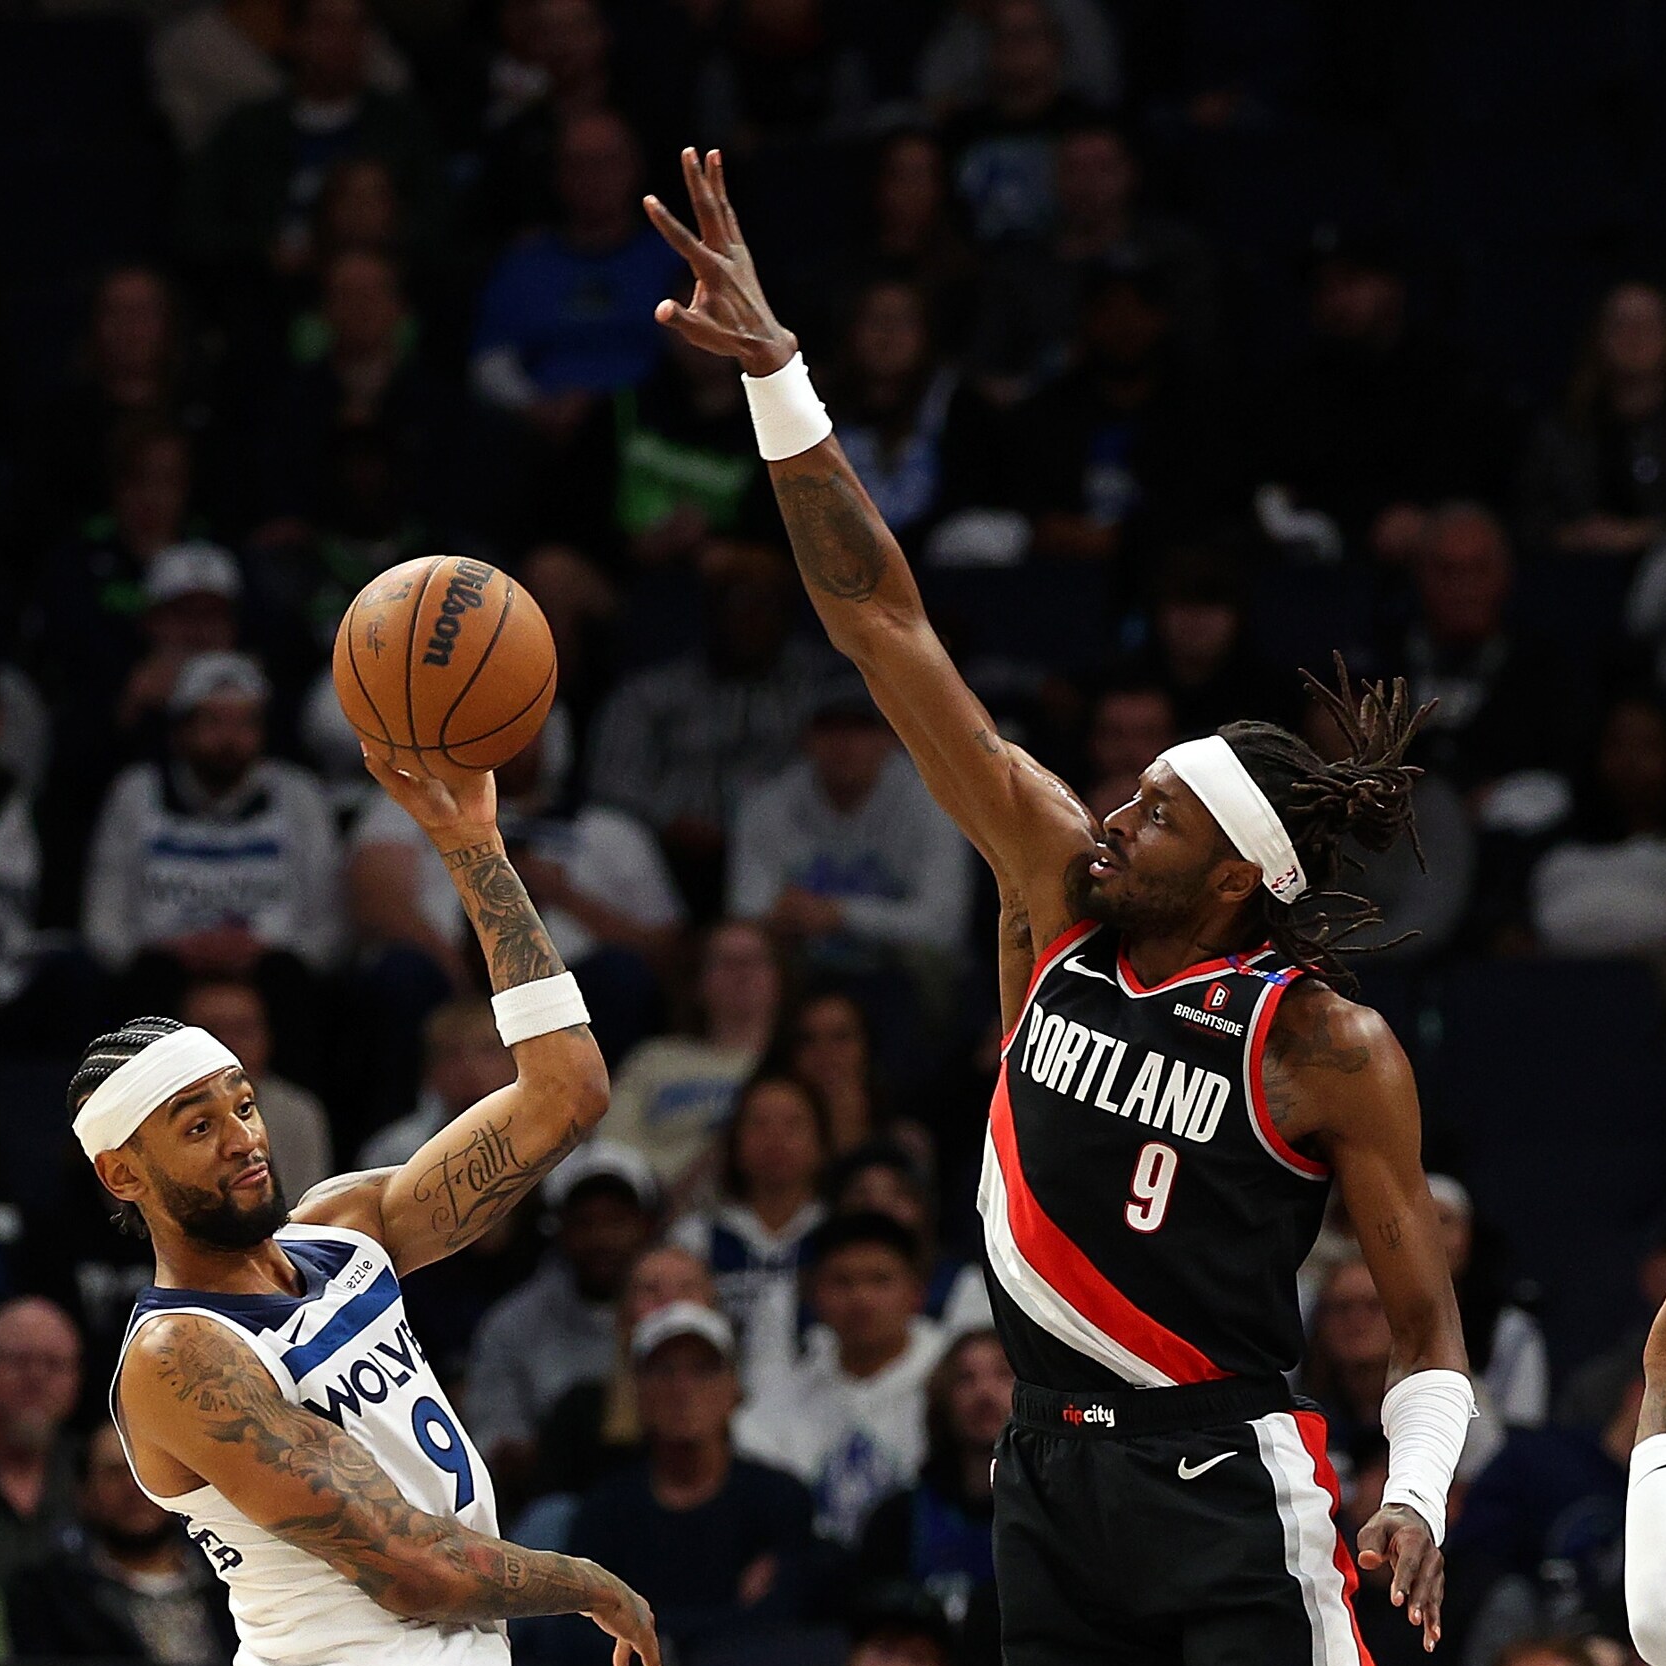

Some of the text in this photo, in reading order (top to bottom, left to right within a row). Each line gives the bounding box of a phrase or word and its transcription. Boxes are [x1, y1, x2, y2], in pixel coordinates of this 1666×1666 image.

[422, 560, 494, 667] Wilson
[1173, 1003, 1244, 1037] BRIGHTSIDE
[1020, 1001, 1231, 1143] PORTLAND
[414, 1116, 528, 1234] Faith
[1122, 1139, 1181, 1234] 9
[344, 1259, 374, 1292] ezzle
[412, 1396, 475, 1514] 9
[1061, 1403, 1115, 1428] ripcity
